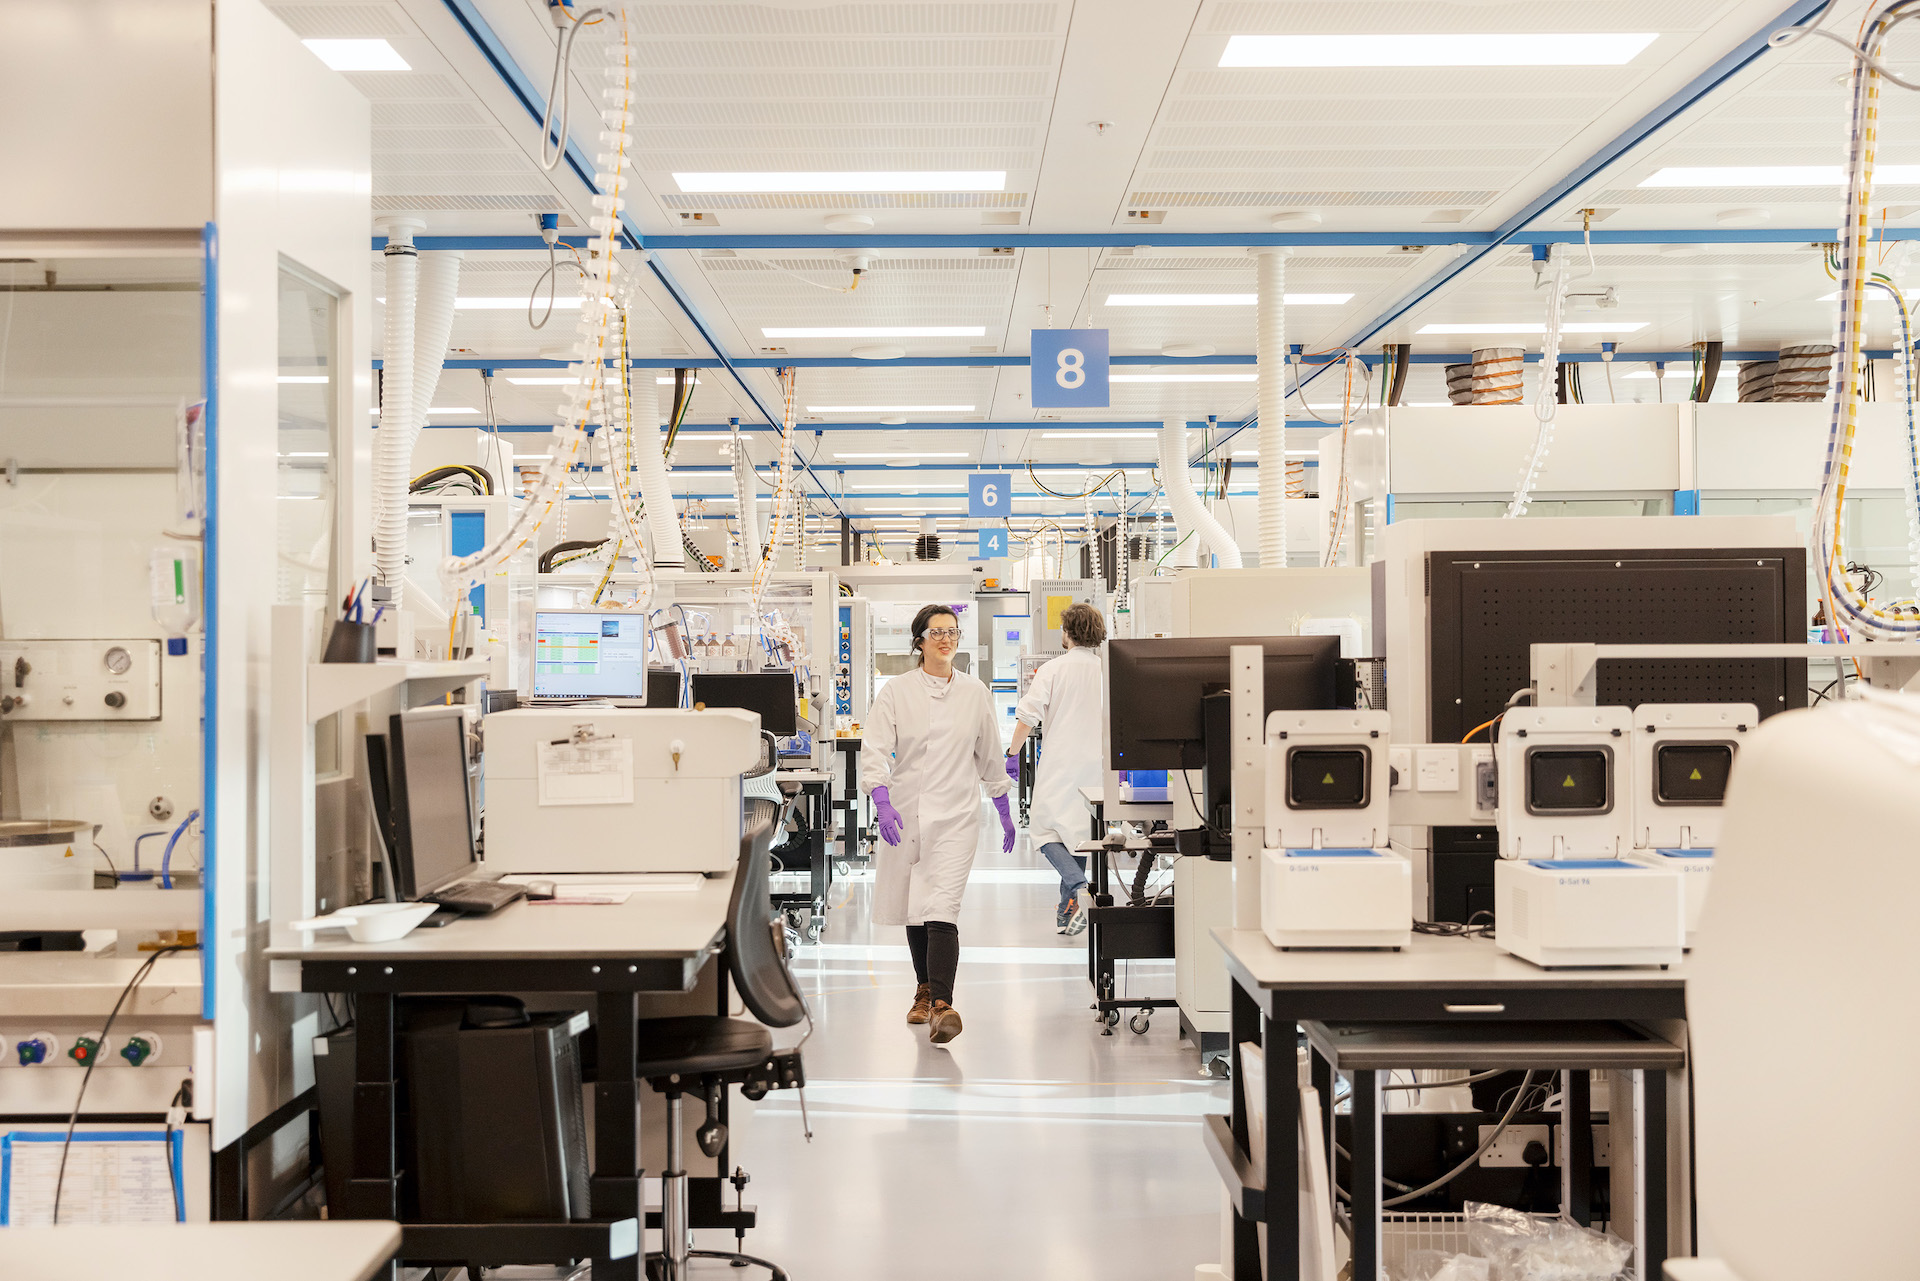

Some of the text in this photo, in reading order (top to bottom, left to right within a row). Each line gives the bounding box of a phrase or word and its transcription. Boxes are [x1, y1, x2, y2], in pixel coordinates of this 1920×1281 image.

[1056, 348, 1085, 389] 8
[982, 483, 998, 506] 6
[987, 535, 999, 550] 4
